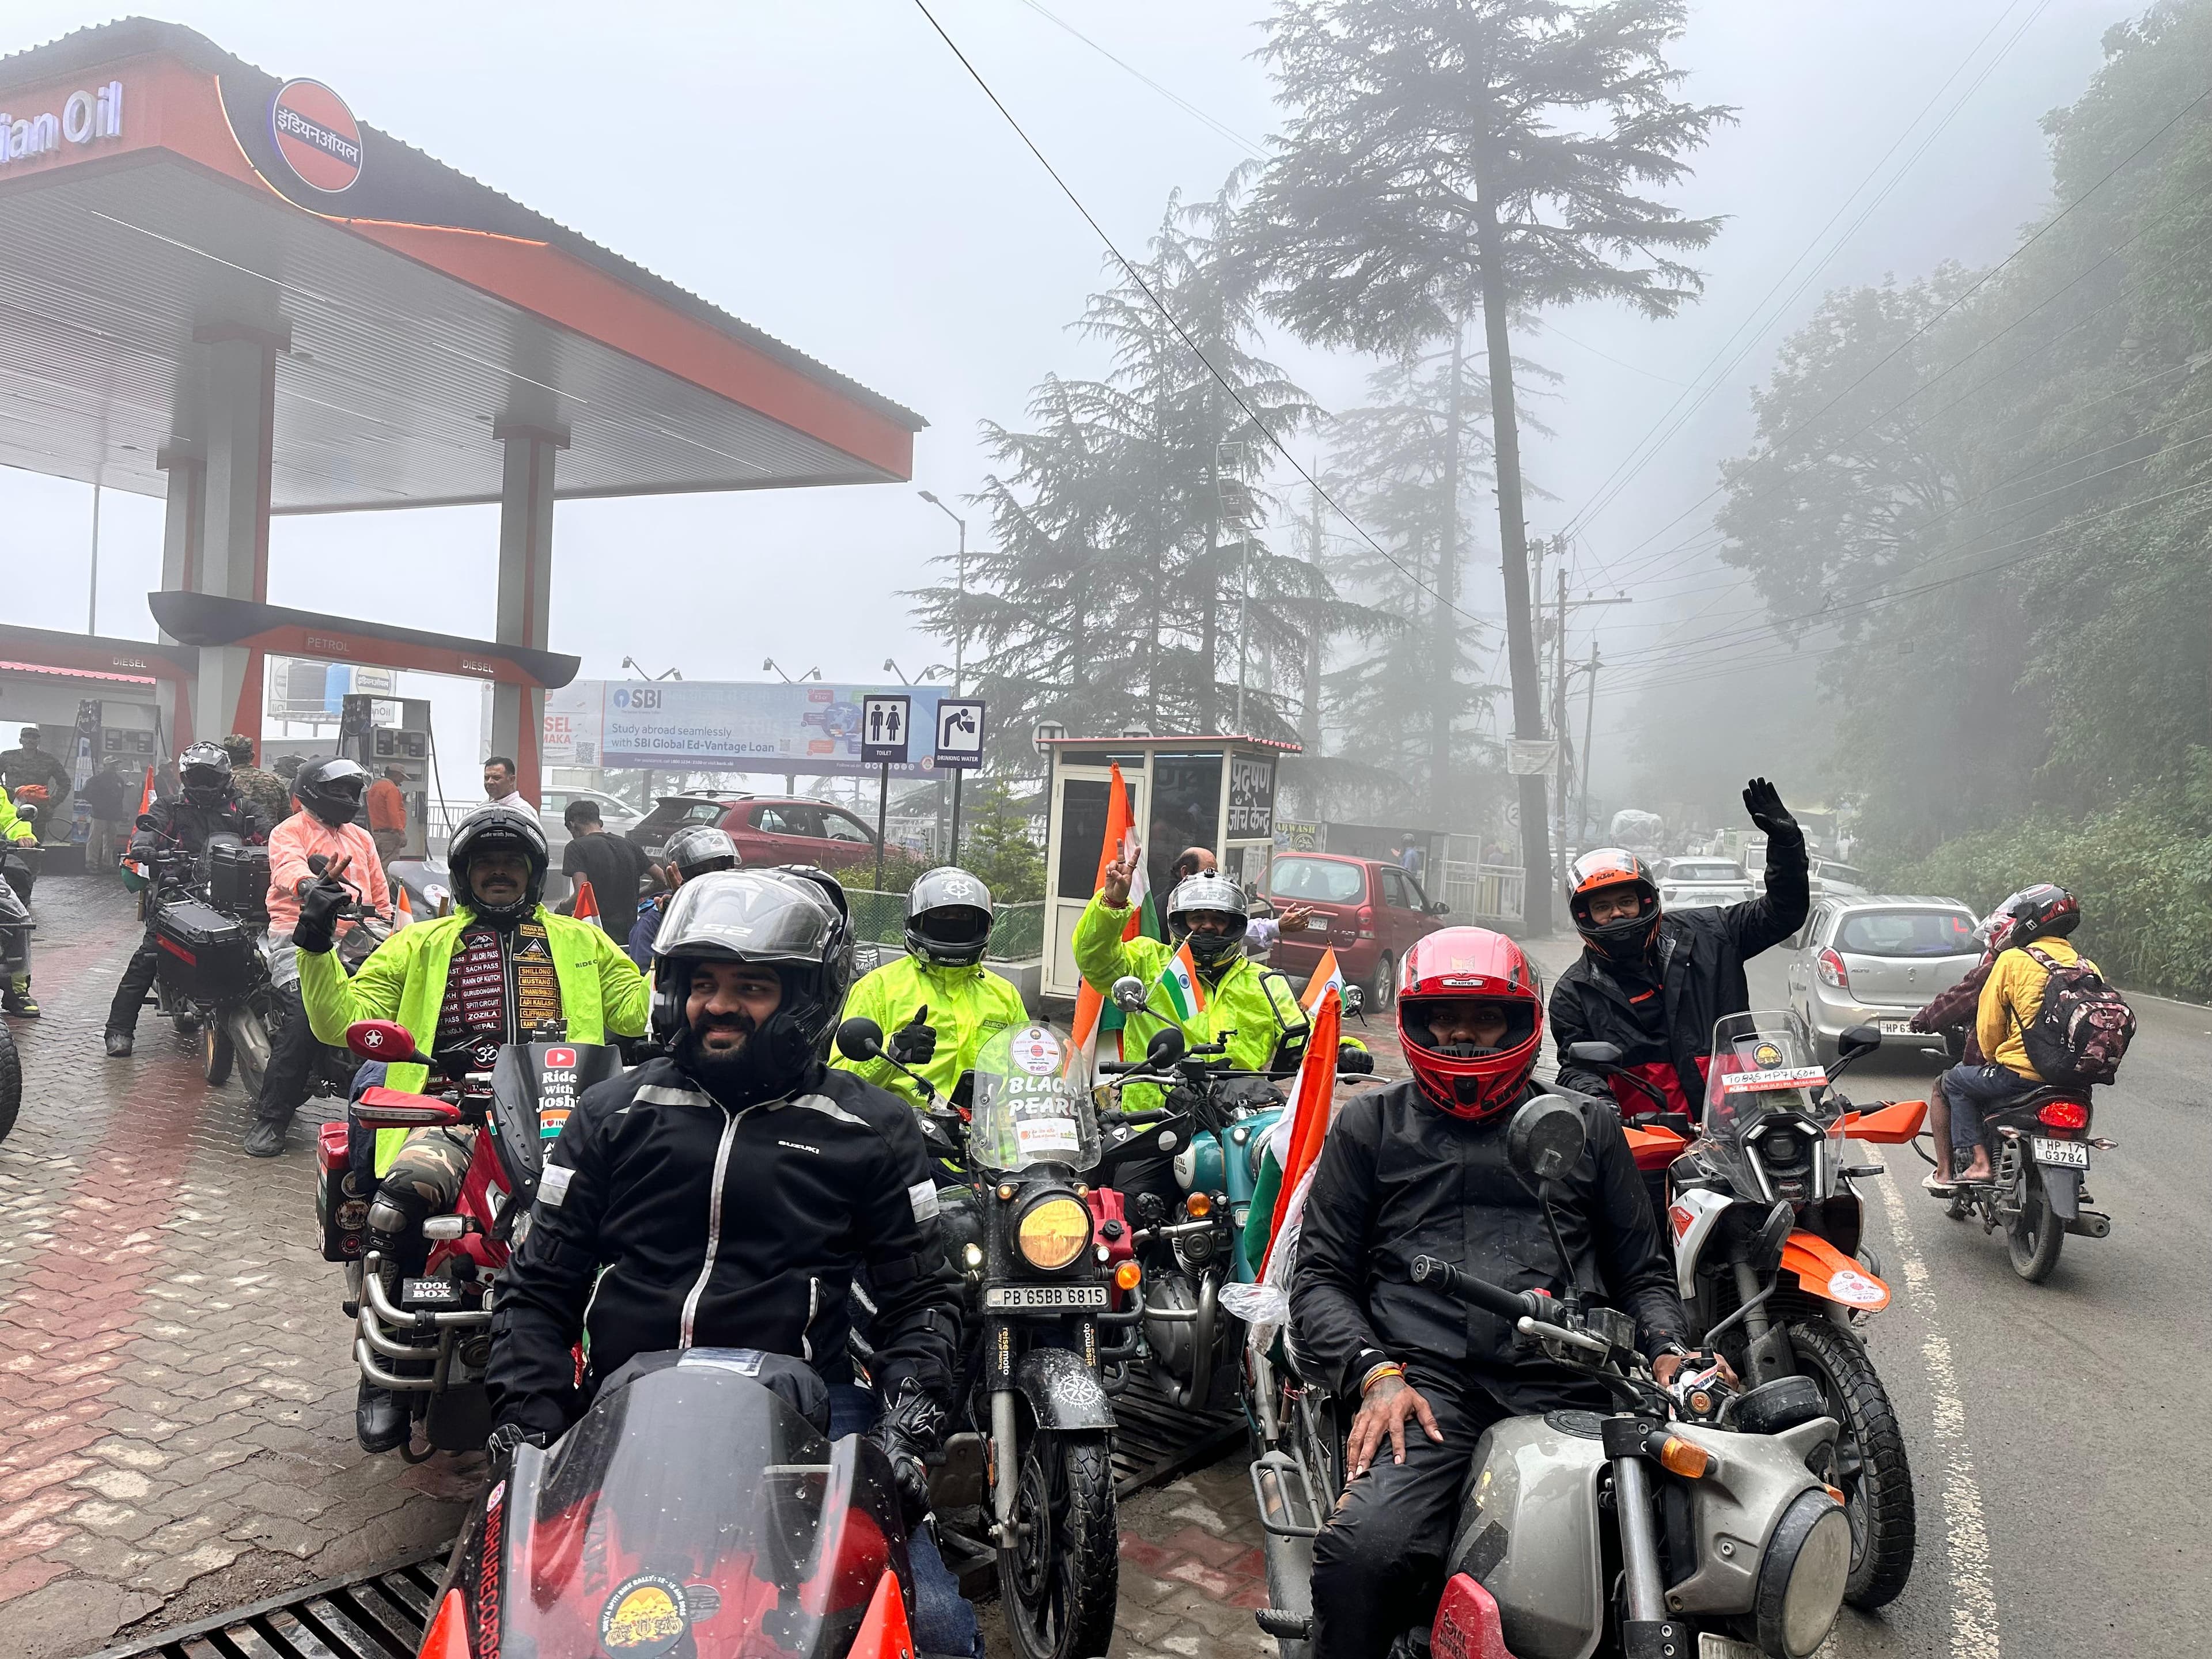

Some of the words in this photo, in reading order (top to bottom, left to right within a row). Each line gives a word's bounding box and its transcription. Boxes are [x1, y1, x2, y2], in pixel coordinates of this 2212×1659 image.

[62, 80, 123, 144] Oil
[277, 109, 358, 162] इंडियनऑयल
[308, 637, 350, 653] PETROL
[113, 657, 146, 668] DIESEL
[463, 659, 494, 673] DIESEL
[631, 689, 662, 709] SBI
[612, 723, 640, 736] Study
[642, 725, 676, 735] abroad
[677, 726, 732, 739] seamlessly
[612, 737, 632, 747] with
[634, 738, 650, 747] SBI
[653, 739, 685, 749] Global
[687, 740, 747, 753] Ed-Vantage
[749, 742, 774, 752] Loan
[1232, 758, 1272, 801] प्रदूषण
[1228, 795, 1249, 831] जाँच
[1597, 872, 1615, 881] KTM
[684, 923, 753, 937] LS2
[471, 952, 487, 961] JALORI
[487, 950, 499, 959] PASS
[463, 987, 501, 997] GURUDONGMAR
[479, 999, 499, 1007] CIRCUIT
[445, 1016, 460, 1024] PASS
[468, 1011, 497, 1020] ZOZILA
[472, 1022, 497, 1031] NEPAL
[1887, 1024, 1897, 1033] HP
[542, 1070, 577, 1084] Ride
[544, 1083, 574, 1094] with
[1009, 1076, 1076, 1094] BLACK
[536, 1094, 581, 1113] Joshi
[1008, 1097, 1078, 1117] PEARL
[778, 1141, 819, 1154] SUZUKI
[2047, 1140, 2061, 1150] HP
[2068, 1143, 2080, 1153] 17
[2046, 1150, 2083, 1164] G3784
[1004, 1290, 1021, 1305] PB
[1027, 1290, 1062, 1304] 65BB
[1068, 1289, 1103, 1303] 6815
[1084, 1323, 1092, 1367] eisemoto
[632, 1575, 656, 1585] RALLY:
